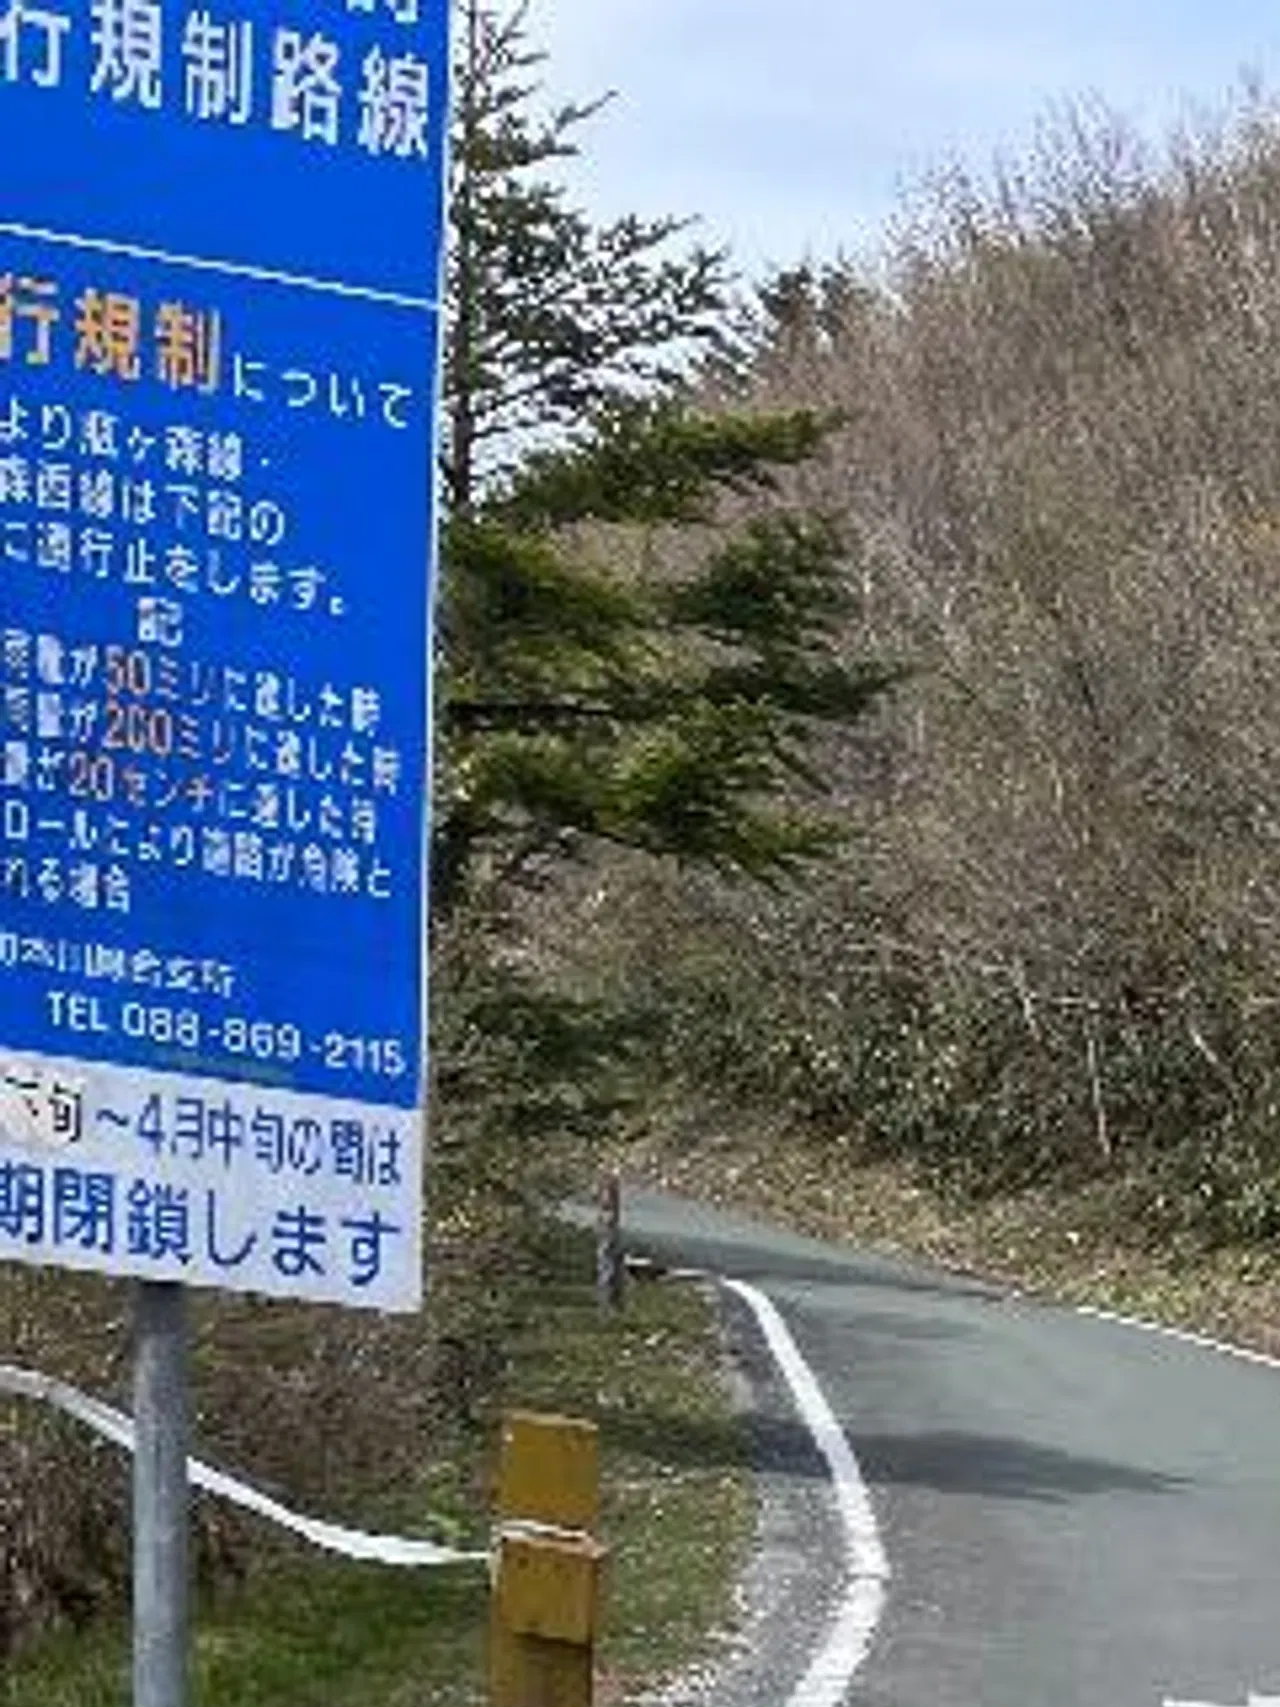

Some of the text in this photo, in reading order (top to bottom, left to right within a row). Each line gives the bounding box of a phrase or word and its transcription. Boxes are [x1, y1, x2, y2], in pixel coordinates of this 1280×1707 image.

[137, 596, 183, 647] 記
[47, 991, 406, 1076] TEL 088-869-2115
